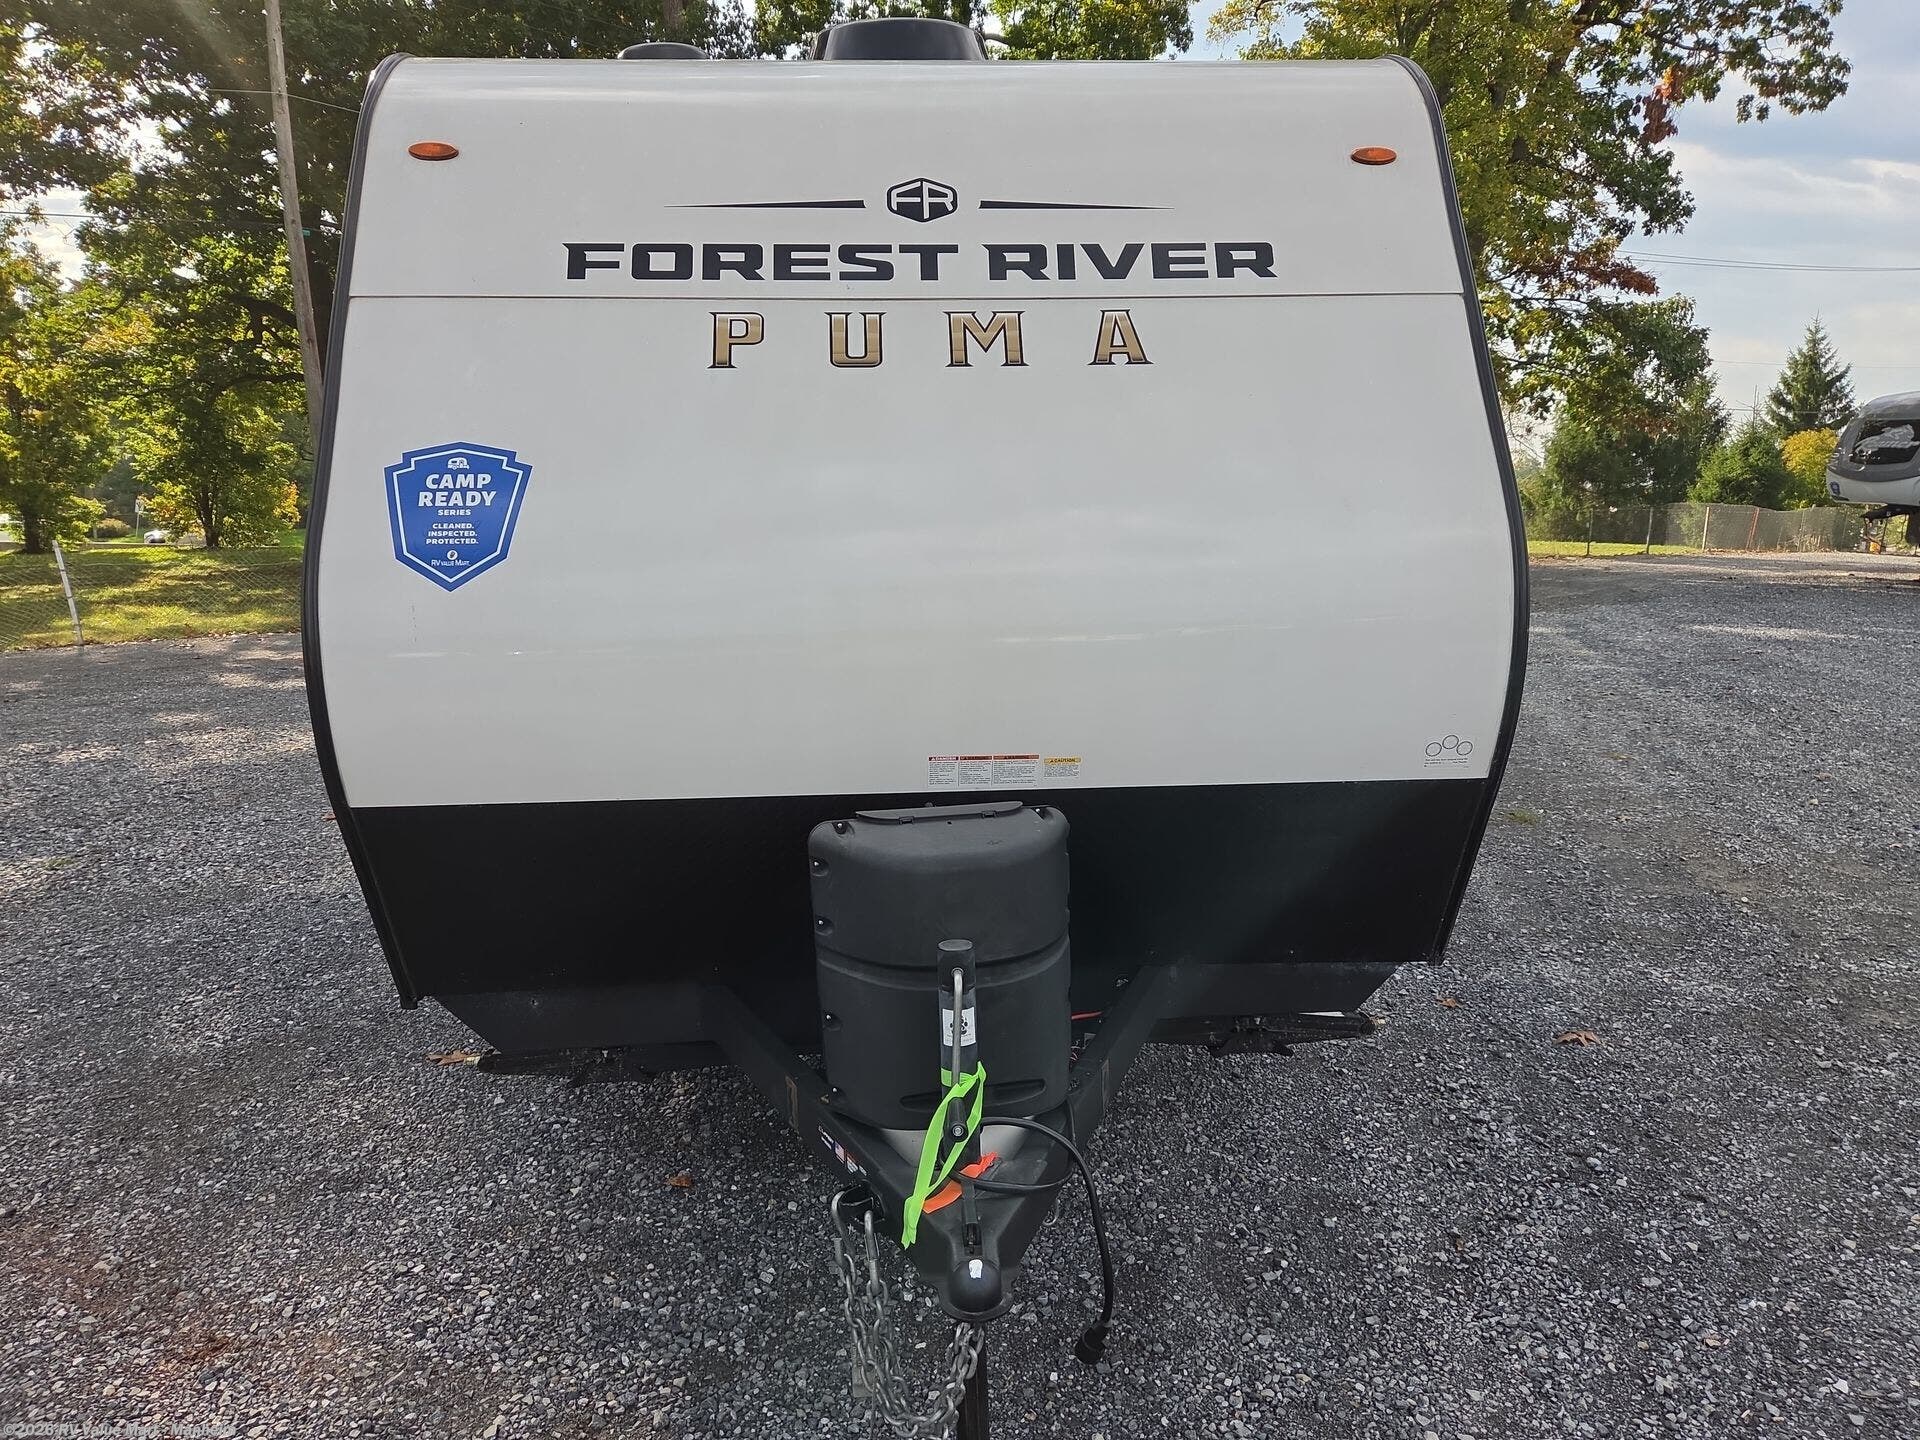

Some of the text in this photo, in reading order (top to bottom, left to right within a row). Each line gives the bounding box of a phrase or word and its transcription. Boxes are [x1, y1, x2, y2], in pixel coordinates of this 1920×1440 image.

[562, 242, 1278, 281] FOREST RIVER
[707, 309, 1154, 369] PUMA
[426, 474, 492, 489] CAMP
[418, 491, 496, 507] READY
